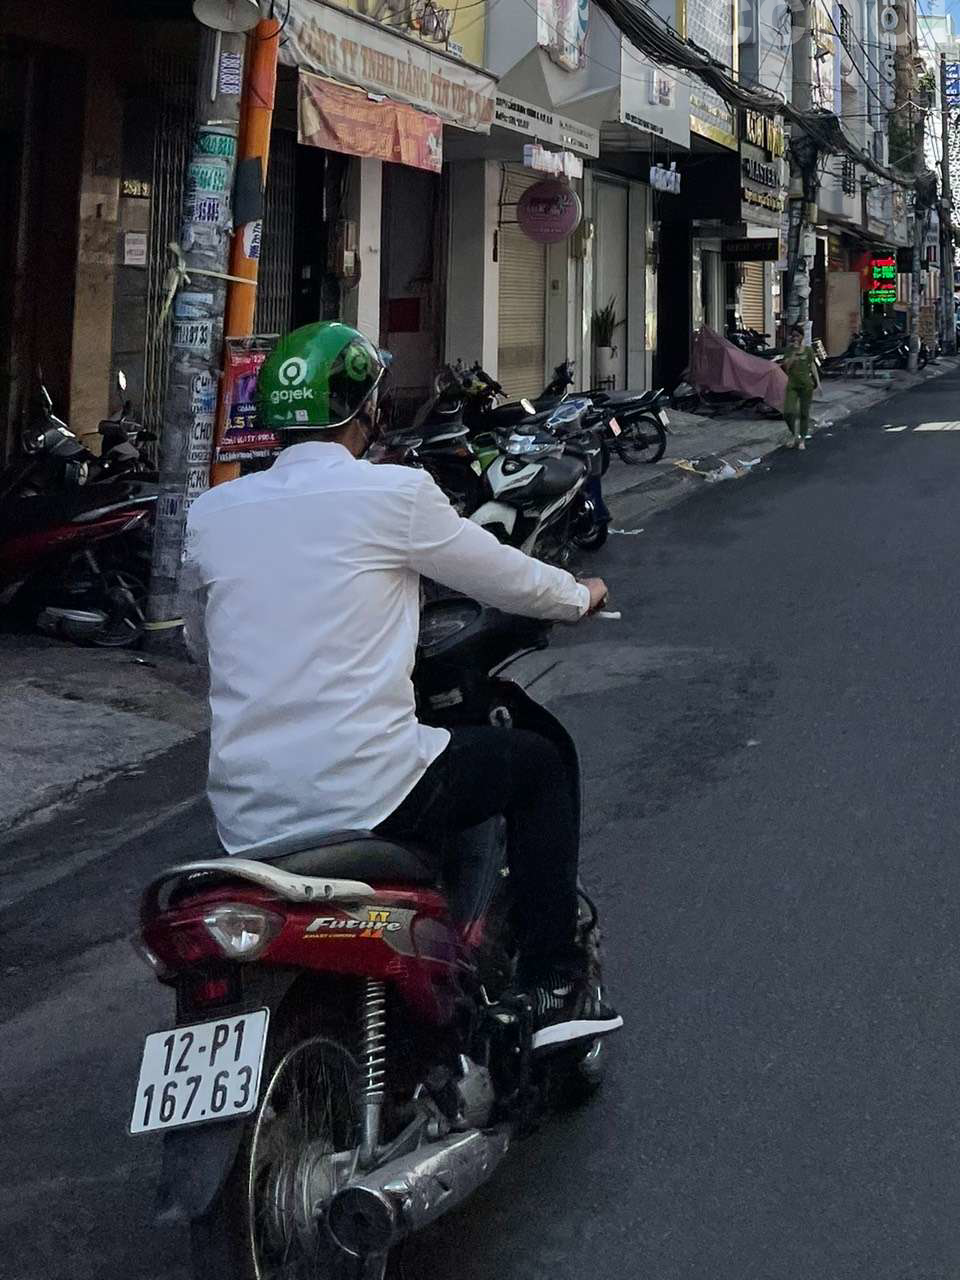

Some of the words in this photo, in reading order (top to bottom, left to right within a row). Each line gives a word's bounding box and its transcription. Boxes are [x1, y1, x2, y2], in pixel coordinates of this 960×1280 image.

[270, 387, 314, 404] gojek
[306, 917, 402, 932] Future
[163, 1020, 246, 1076] 12-P1
[143, 1065, 253, 1126] 167.63
